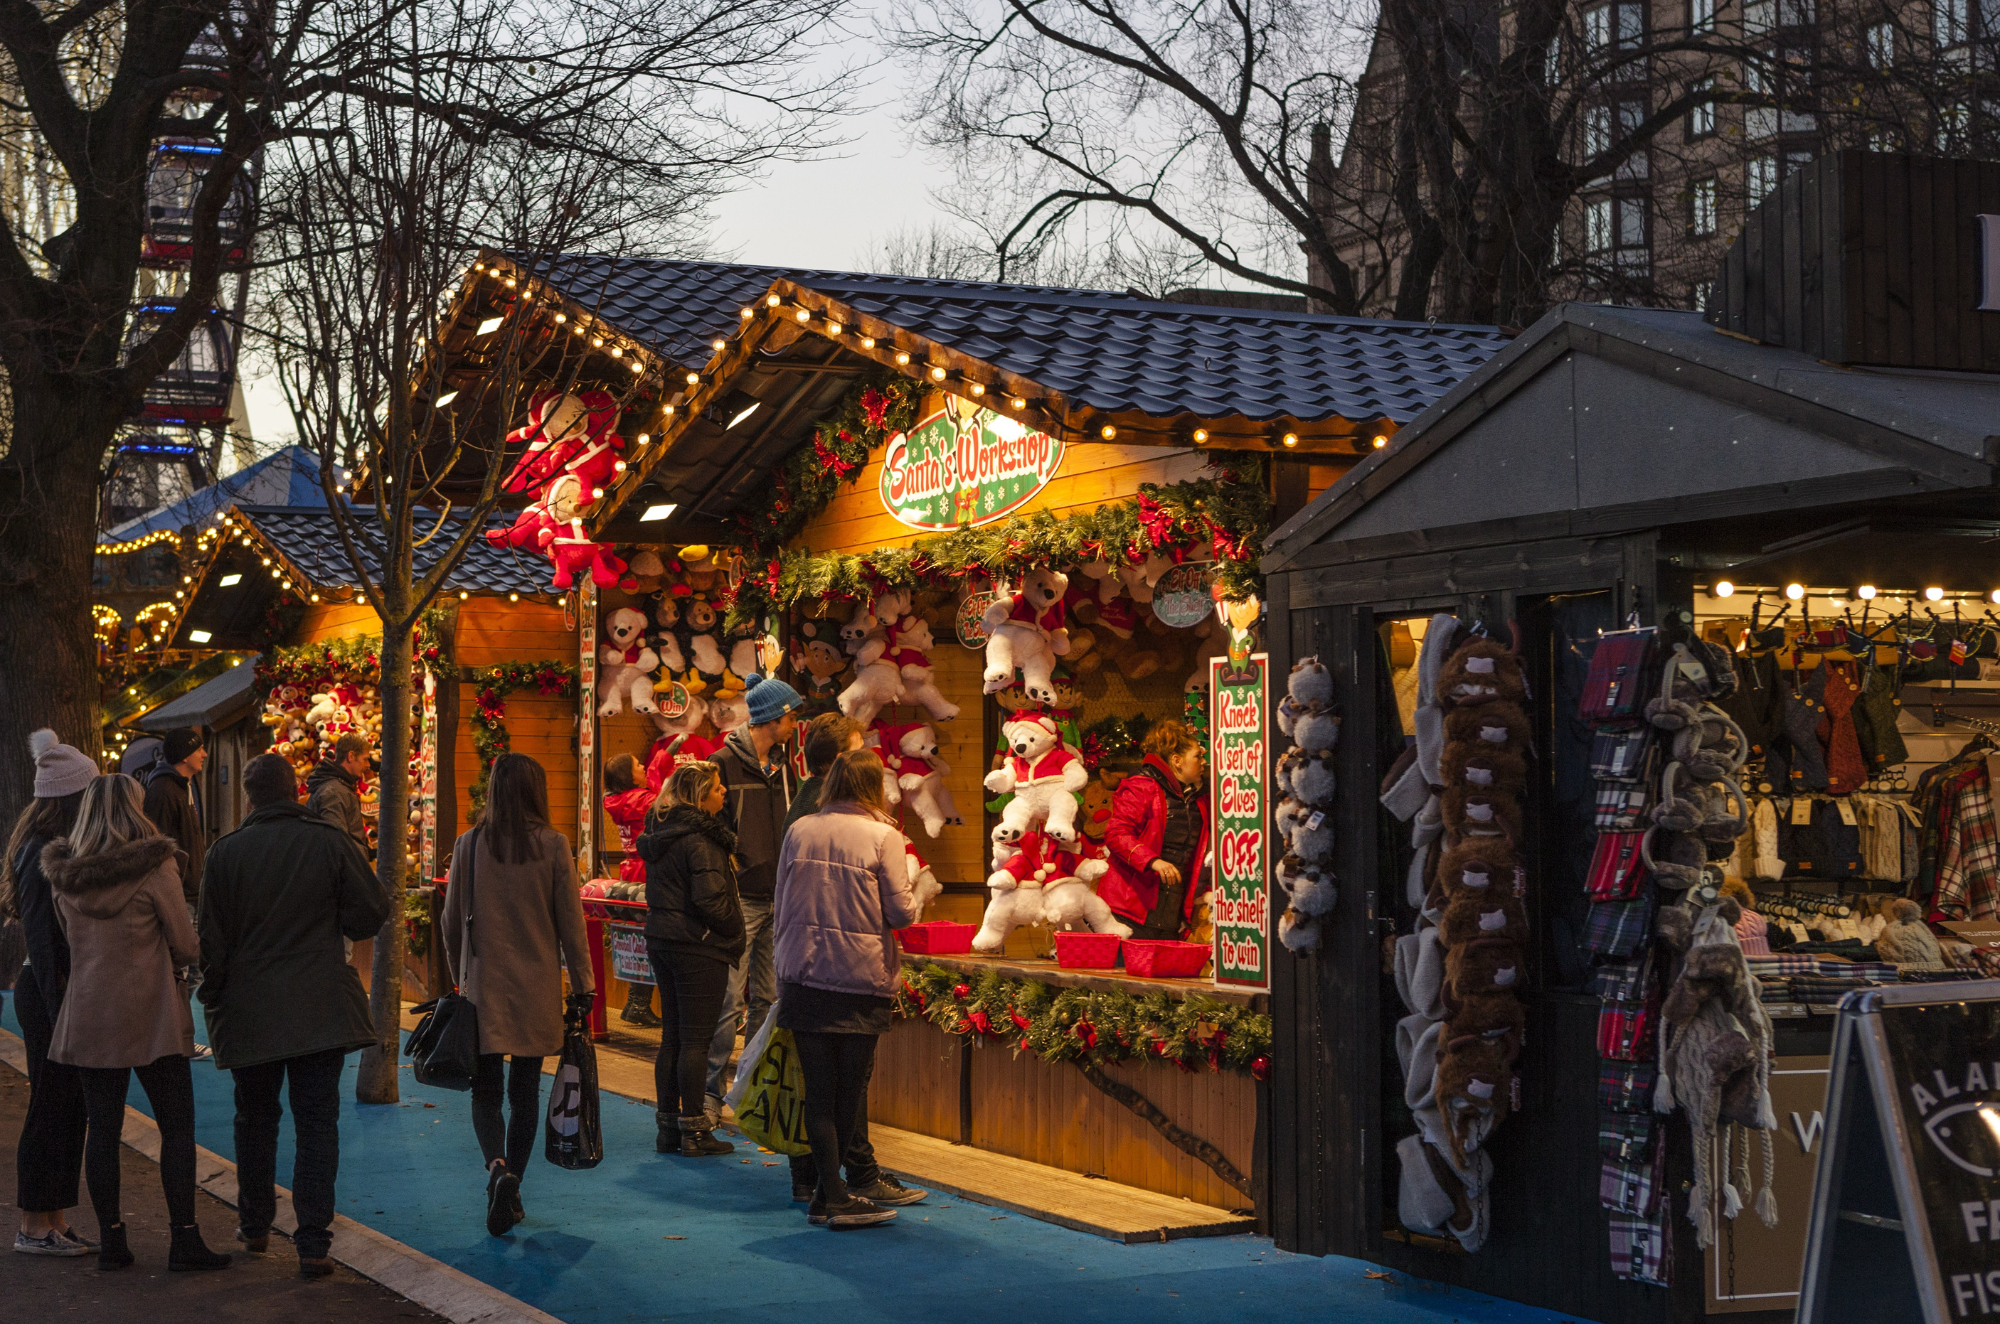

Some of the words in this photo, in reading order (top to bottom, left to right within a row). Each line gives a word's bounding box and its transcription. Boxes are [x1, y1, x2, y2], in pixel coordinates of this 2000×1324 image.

[889, 439, 953, 501] Santa's
[957, 426, 1050, 484] Workshop
[1164, 594, 1180, 615] The
[661, 700, 682, 713] Win
[1220, 693, 1257, 729] Knock
[1217, 735, 1223, 770] 1
[1227, 741, 1244, 771] set
[1247, 743, 1260, 778] of
[1222, 777, 1256, 813] Elves
[1216, 889, 1234, 922] the
[1237, 890, 1265, 932] shelf
[1223, 935, 1235, 965] to
[1238, 939, 1258, 967] win
[1911, 1062, 2000, 1116] ALA
